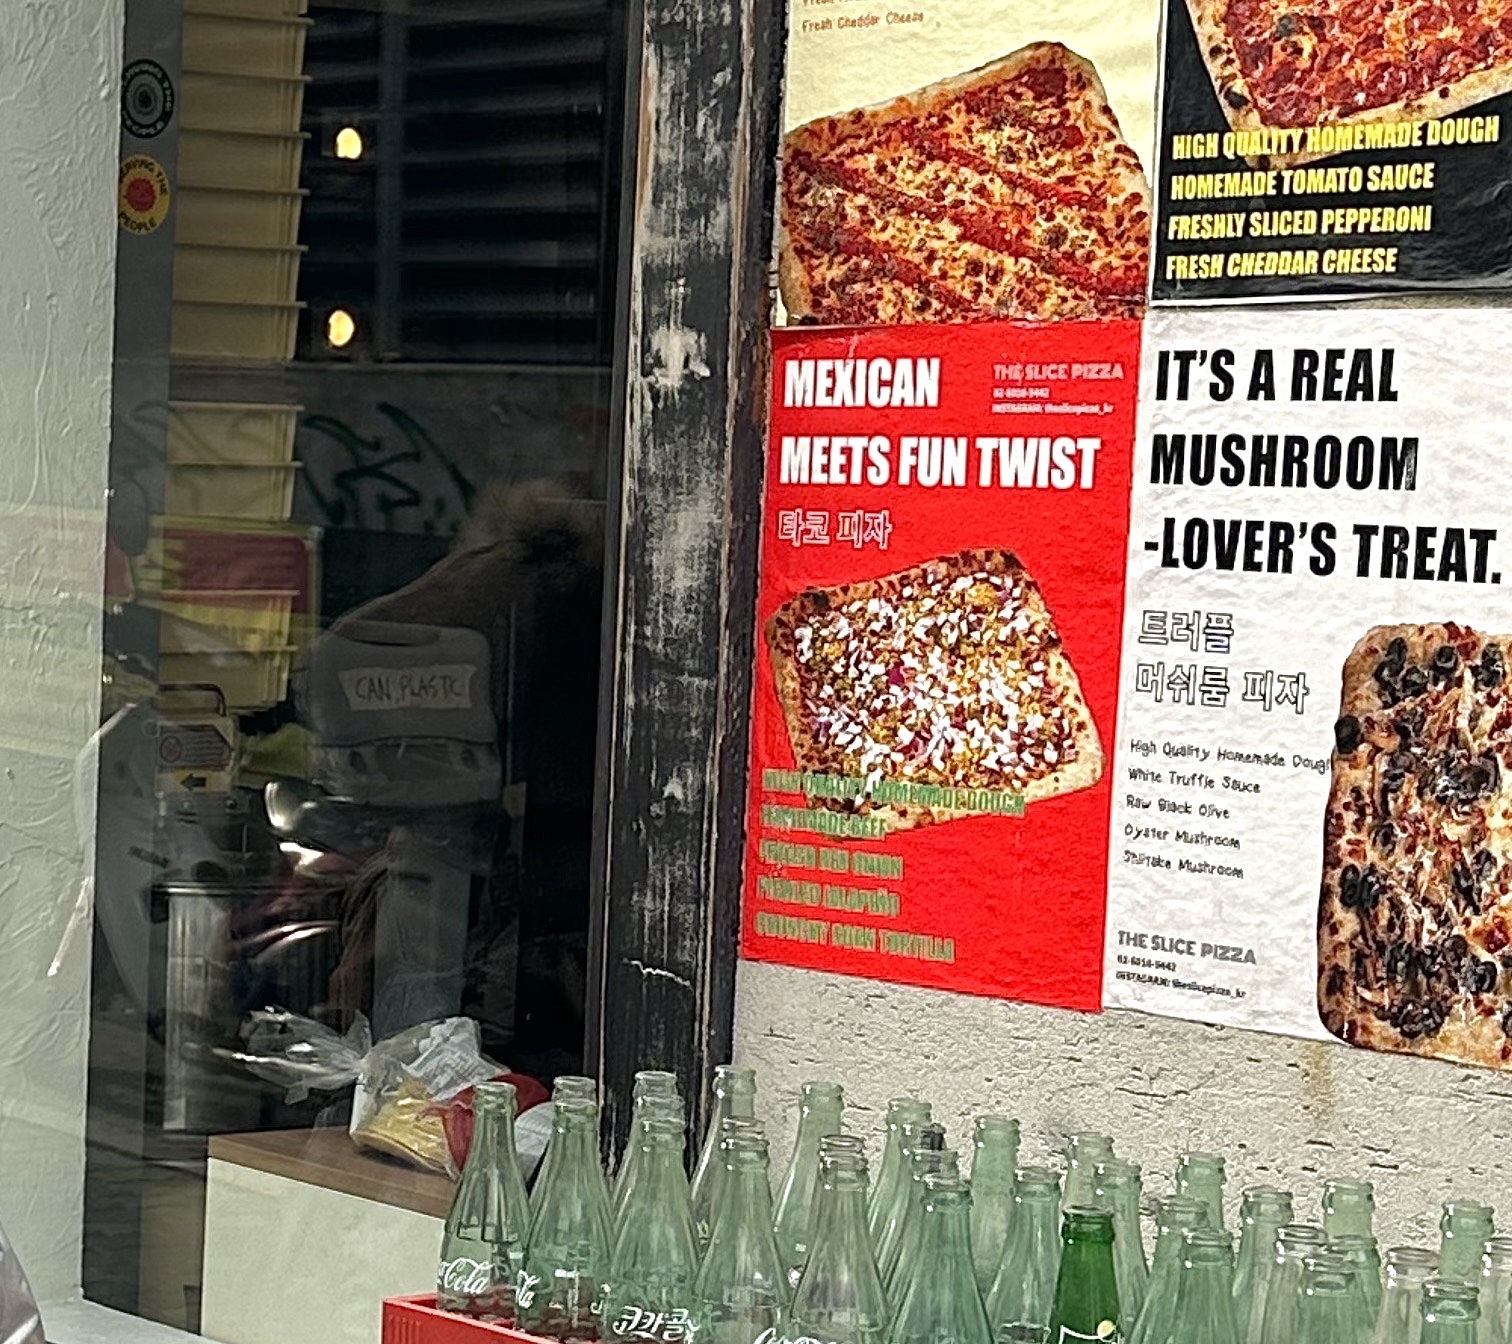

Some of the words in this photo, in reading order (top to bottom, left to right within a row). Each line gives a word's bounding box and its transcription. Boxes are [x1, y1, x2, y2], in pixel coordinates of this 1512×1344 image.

[1172, 134, 1219, 160] HIGH
[1223, 128, 1303, 160] QUALITY
[1306, 119, 1423, 154] HOMEMADE
[1427, 115, 1500, 145] DOUGH
[1171, 171, 1277, 200] HOMEMADE
[1282, 166, 1364, 195] TOMATO
[1367, 163, 1435, 191] SAUCE
[1168, 212, 1246, 240] FRESHLY
[1250, 209, 1318, 238] SLICED
[1322, 205, 1432, 234] PEPPERONI
[1166, 254, 1224, 280] FRESH
[1227, 251, 1319, 277] CHEDDAR
[1322, 247, 1398, 273] CHEESE
[783, 356, 941, 409] MEXICAN
[993, 363, 1024, 381] THE
[1025, 363, 1069, 380] SLICE
[1071, 363, 1124, 379] PIZZA
[1155, 349, 1236, 402] IT'S
[1247, 351, 1277, 401] A
[1289, 348, 1399, 402] REAL
[778, 436, 891, 486] MEETS
[897, 437, 969, 488] FUN
[975, 436, 1104, 490] TWIST
[1149, 434, 1420, 492] MUSHROOM
[778, 509, 830, 546] 타코
[836, 510, 894, 551] 피자
[1144, 517, 1338, 578] -LOVER'S
[1352, 524, 1502, 585] TREAT.
[1136, 608, 1235, 655] 트러플
[1134, 663, 1231, 710] 머쉬룸
[1242, 671, 1310, 715] 피자
[1131, 739, 1157, 756] High
[1163, 742, 1210, 762] Quality
[1217, 746, 1285, 767] Homemade
[1128, 767, 1162, 783] White
[1222, 776, 1261, 794] Sauce
[1118, 930, 1148, 949] THE
[1151, 935, 1196, 956] SLICE
[1200, 942, 1257, 965] PIZZA
